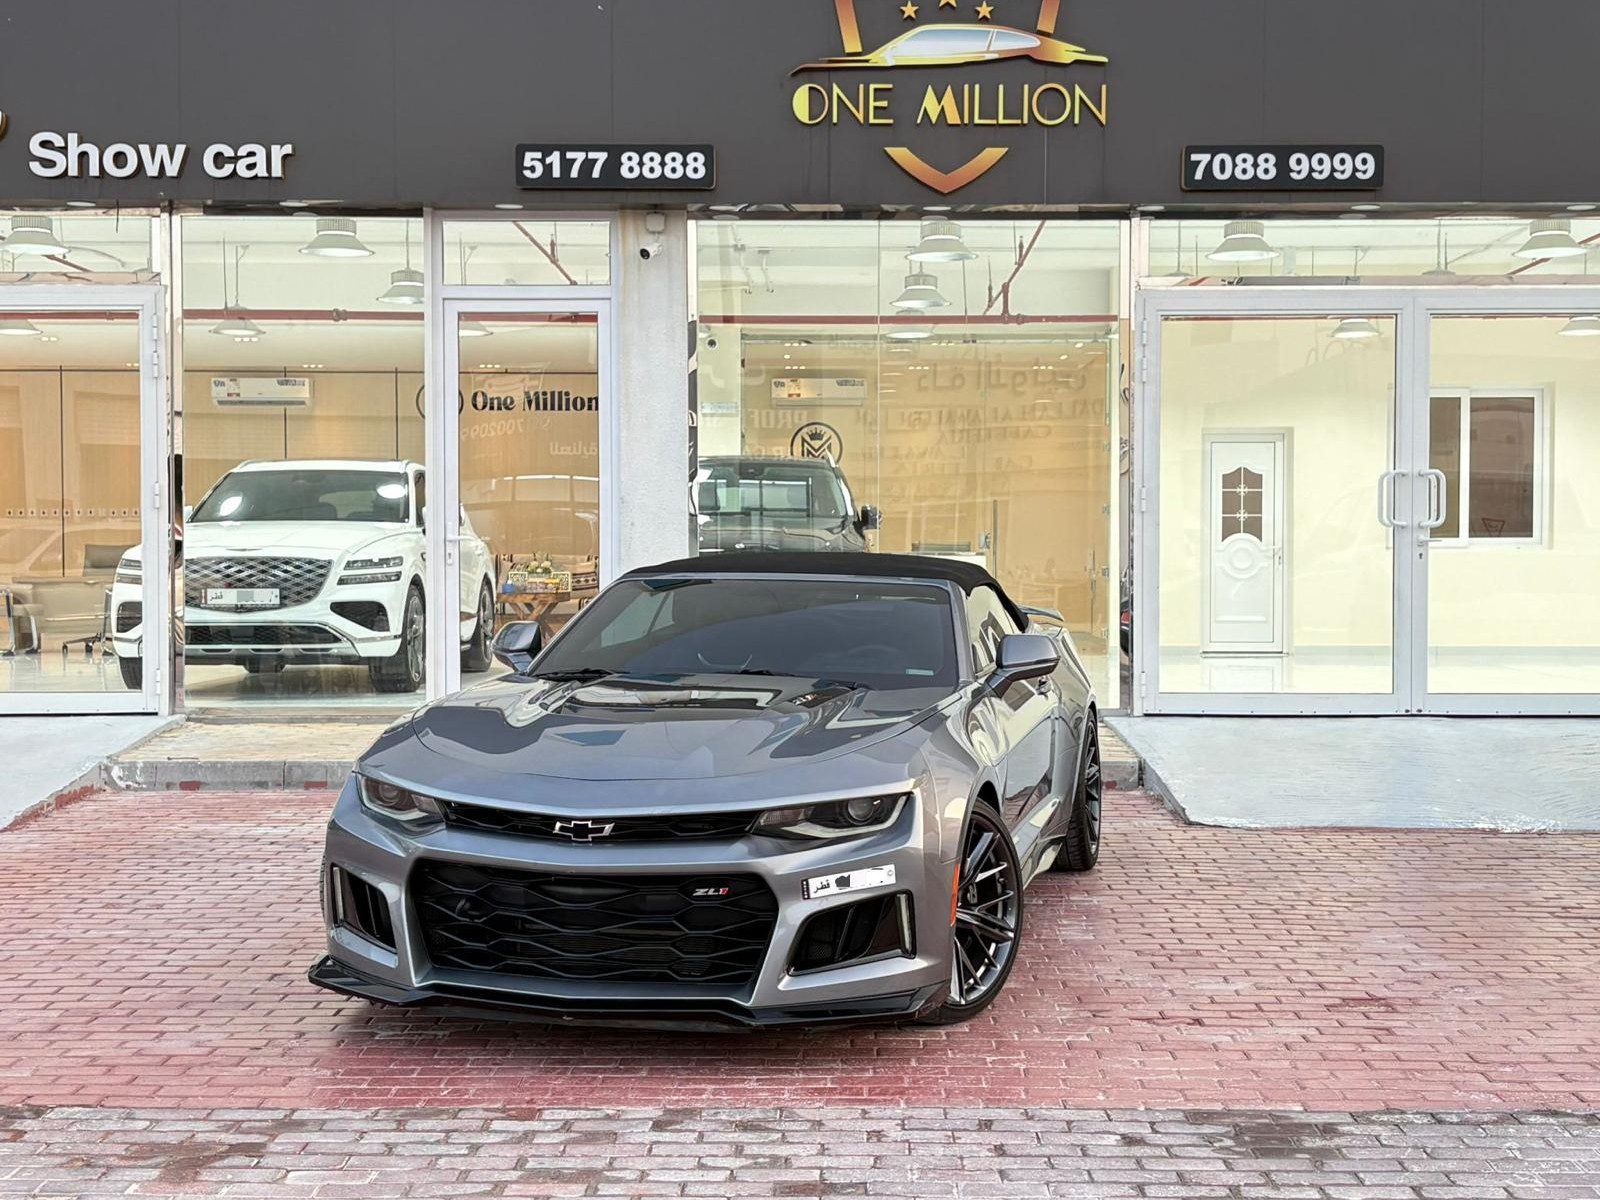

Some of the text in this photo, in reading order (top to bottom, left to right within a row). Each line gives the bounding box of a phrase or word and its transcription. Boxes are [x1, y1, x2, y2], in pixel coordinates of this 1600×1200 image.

[792, 83, 1108, 127] ONE MILLION
[28, 131, 294, 179] Show car
[522, 150, 707, 180] 5177 8888
[1190, 152, 1376, 182] 7088 9999
[471, 390, 599, 411] One Million
[692, 887, 729, 897] ZL1
[814, 879, 831, 894] قطر
